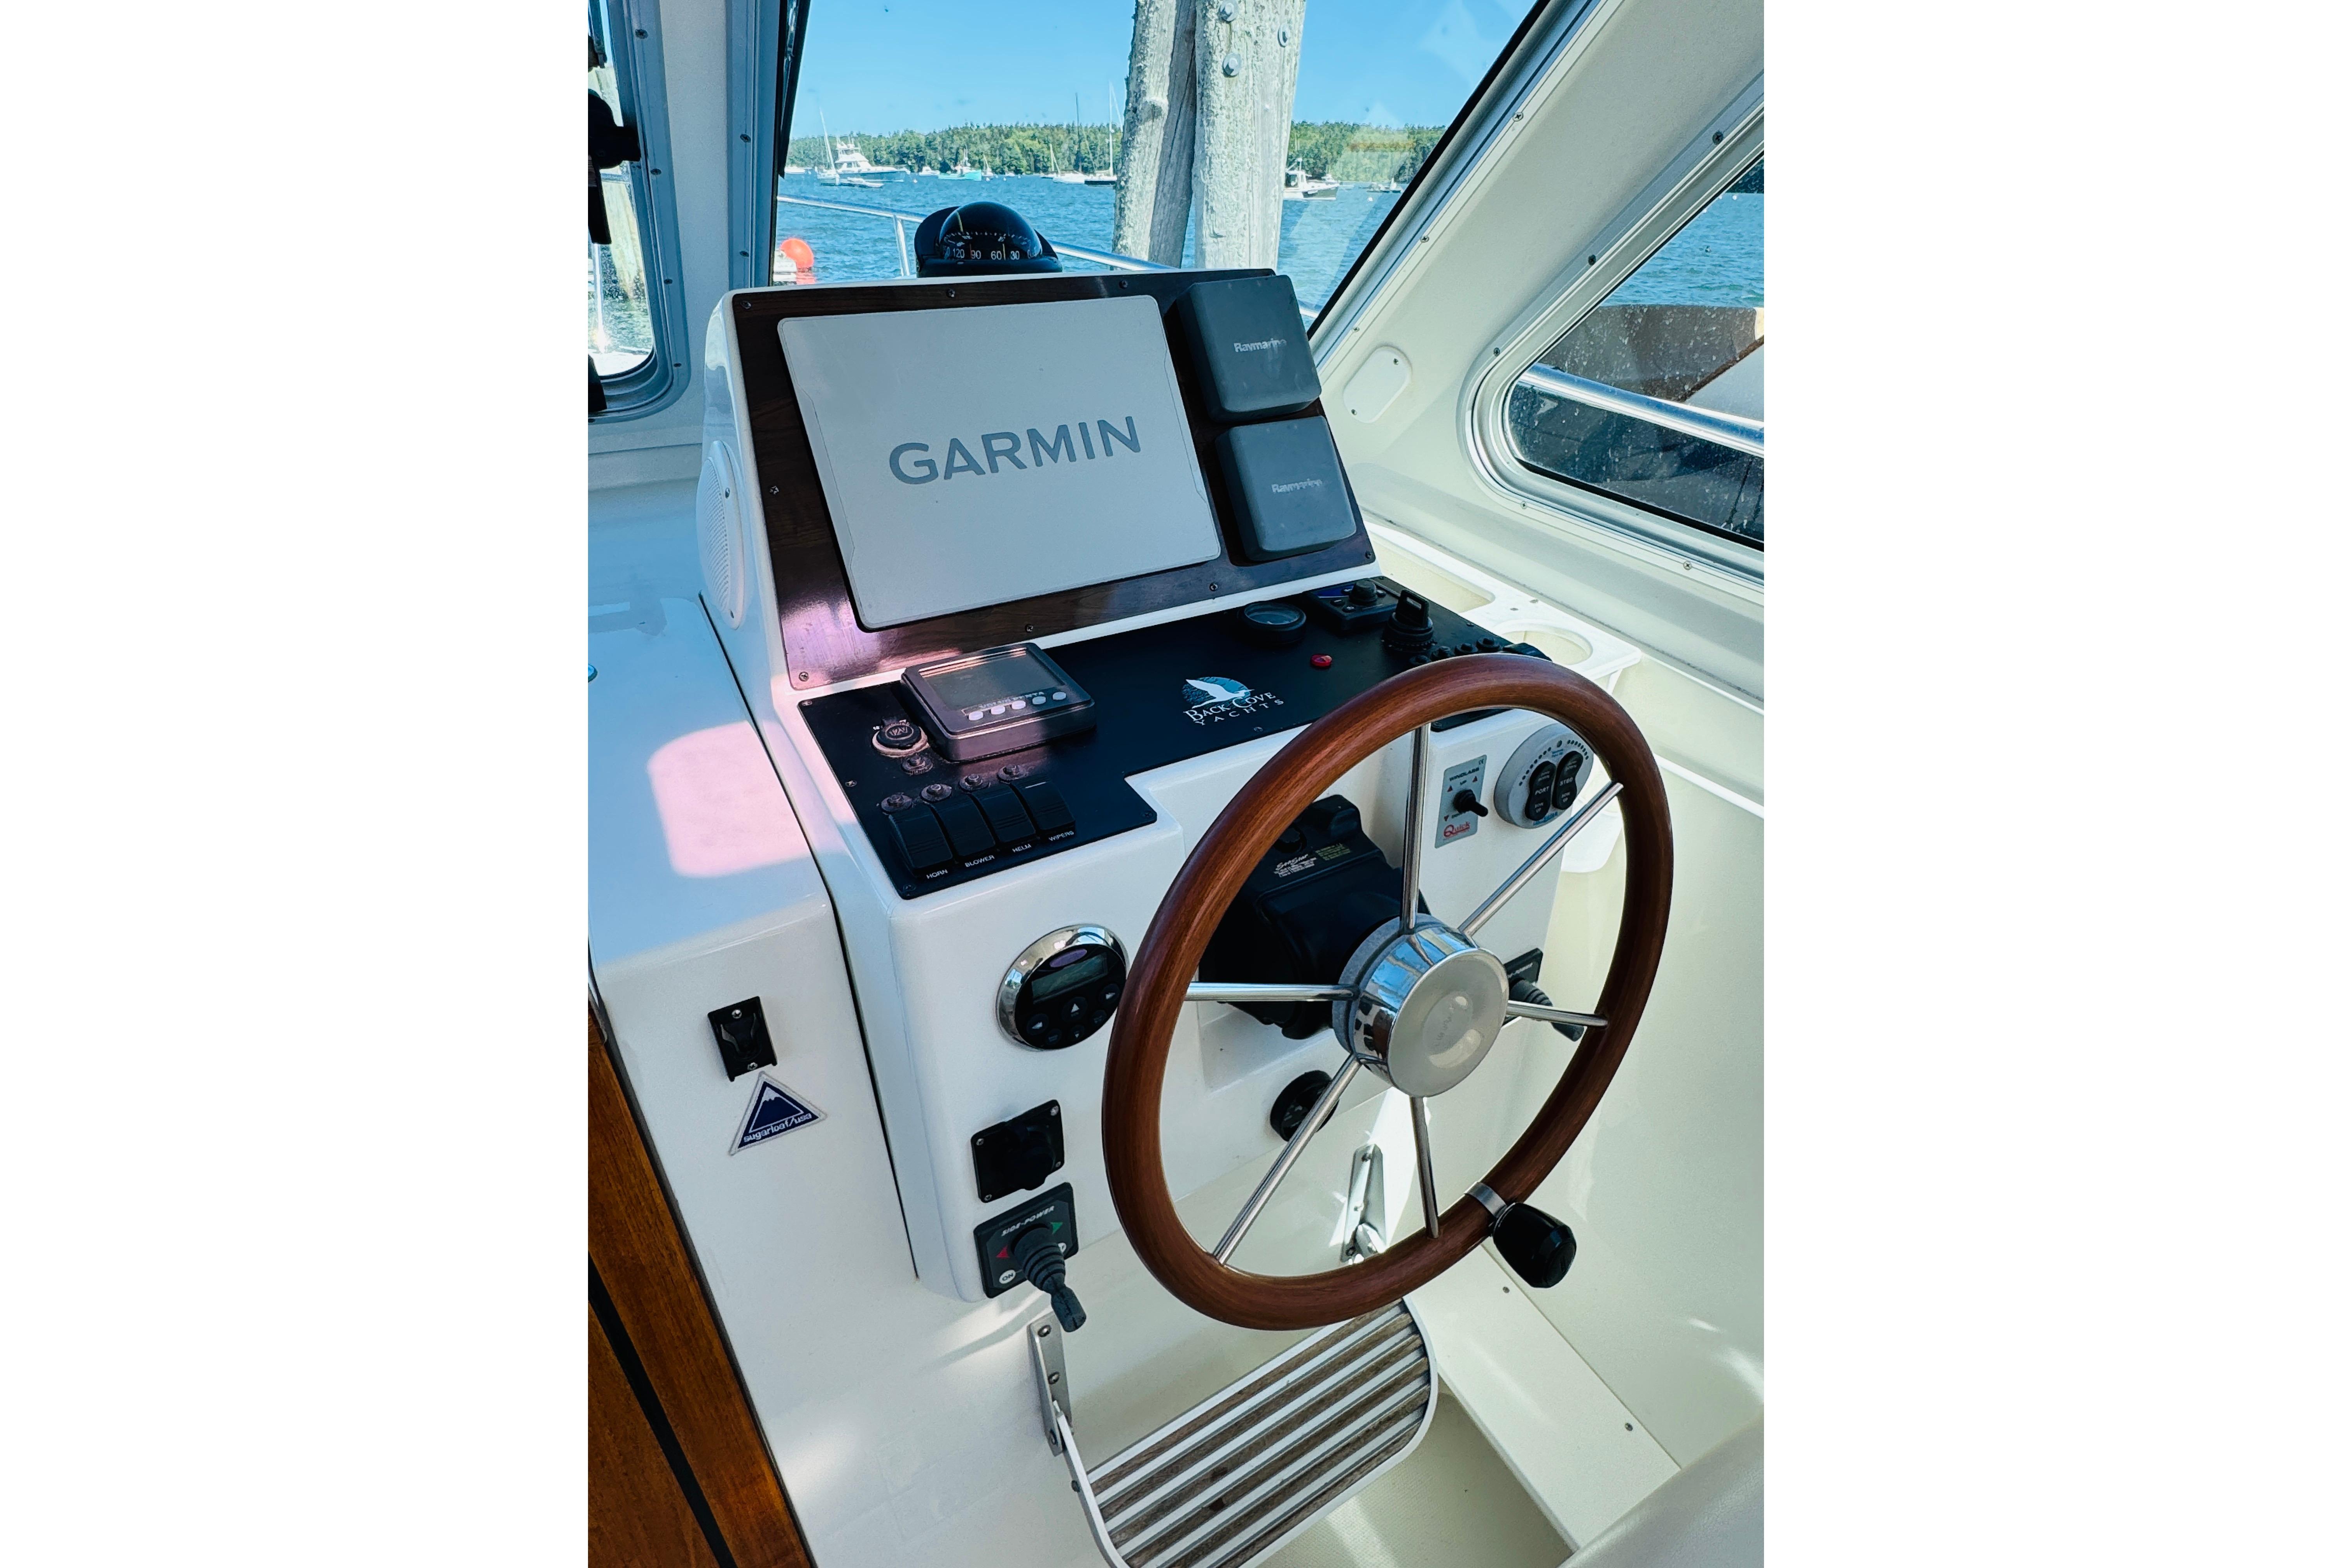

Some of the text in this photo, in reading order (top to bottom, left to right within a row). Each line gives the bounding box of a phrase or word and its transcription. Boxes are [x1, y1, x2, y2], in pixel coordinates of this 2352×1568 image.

[953, 248, 965, 259] 120
[972, 250, 981, 259] 90
[991, 250, 1002, 260] 60
[1011, 250, 1020, 260] 30
[889, 416, 1141, 485] GARMIN
[1195, 699, 1284, 726] YACHTS
[1443, 821, 1470, 838] Quick
[1048, 831, 1074, 841] WIPERS
[1012, 844, 1032, 852] HELM
[964, 855, 995, 867] BLOWER
[926, 869, 948, 879] HORN
[1002, 1273, 1013, 1281] ON
